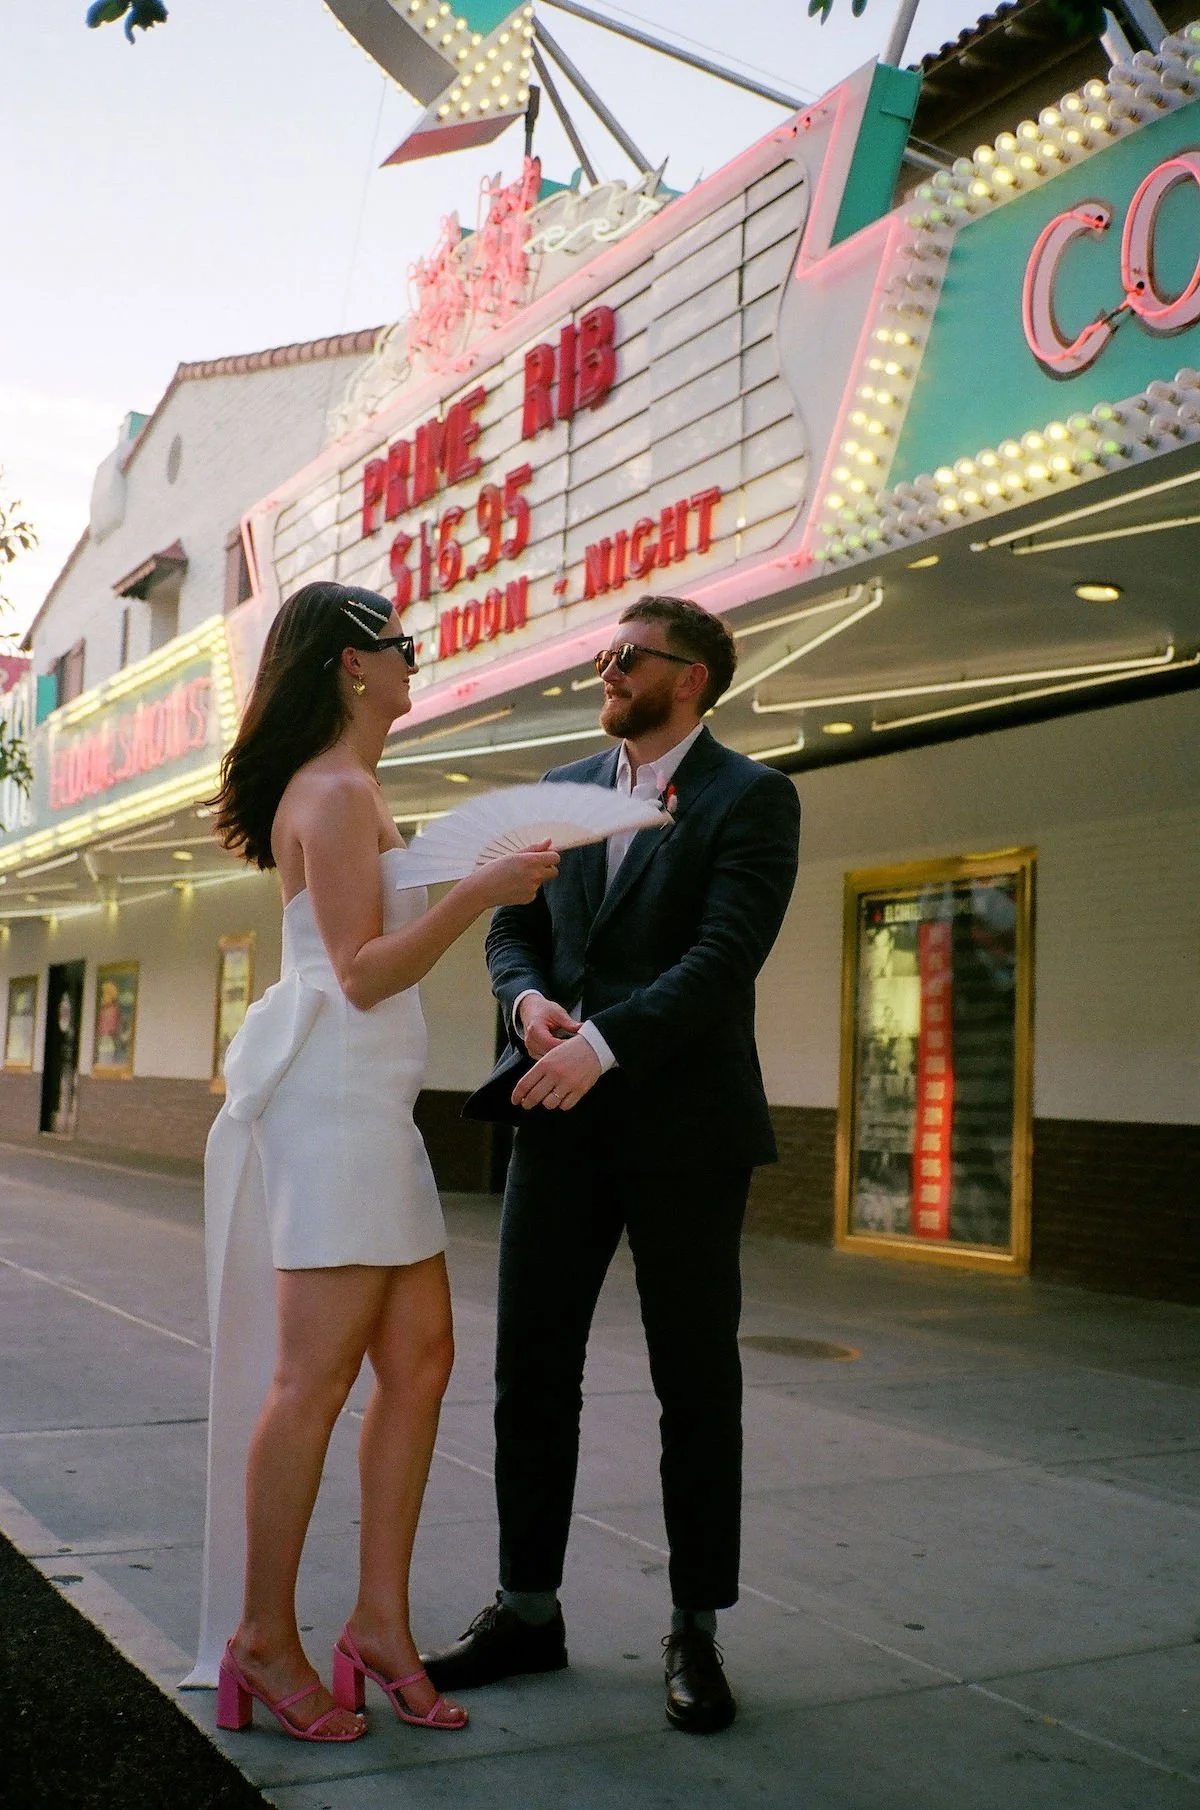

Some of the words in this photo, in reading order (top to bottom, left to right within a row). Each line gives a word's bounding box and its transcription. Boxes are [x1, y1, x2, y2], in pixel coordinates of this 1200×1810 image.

[361, 386, 486, 538] PRIME
[521, 305, 616, 439] RIB
[438, 575, 528, 660] NOON
[584, 486, 721, 600] NIGHT
